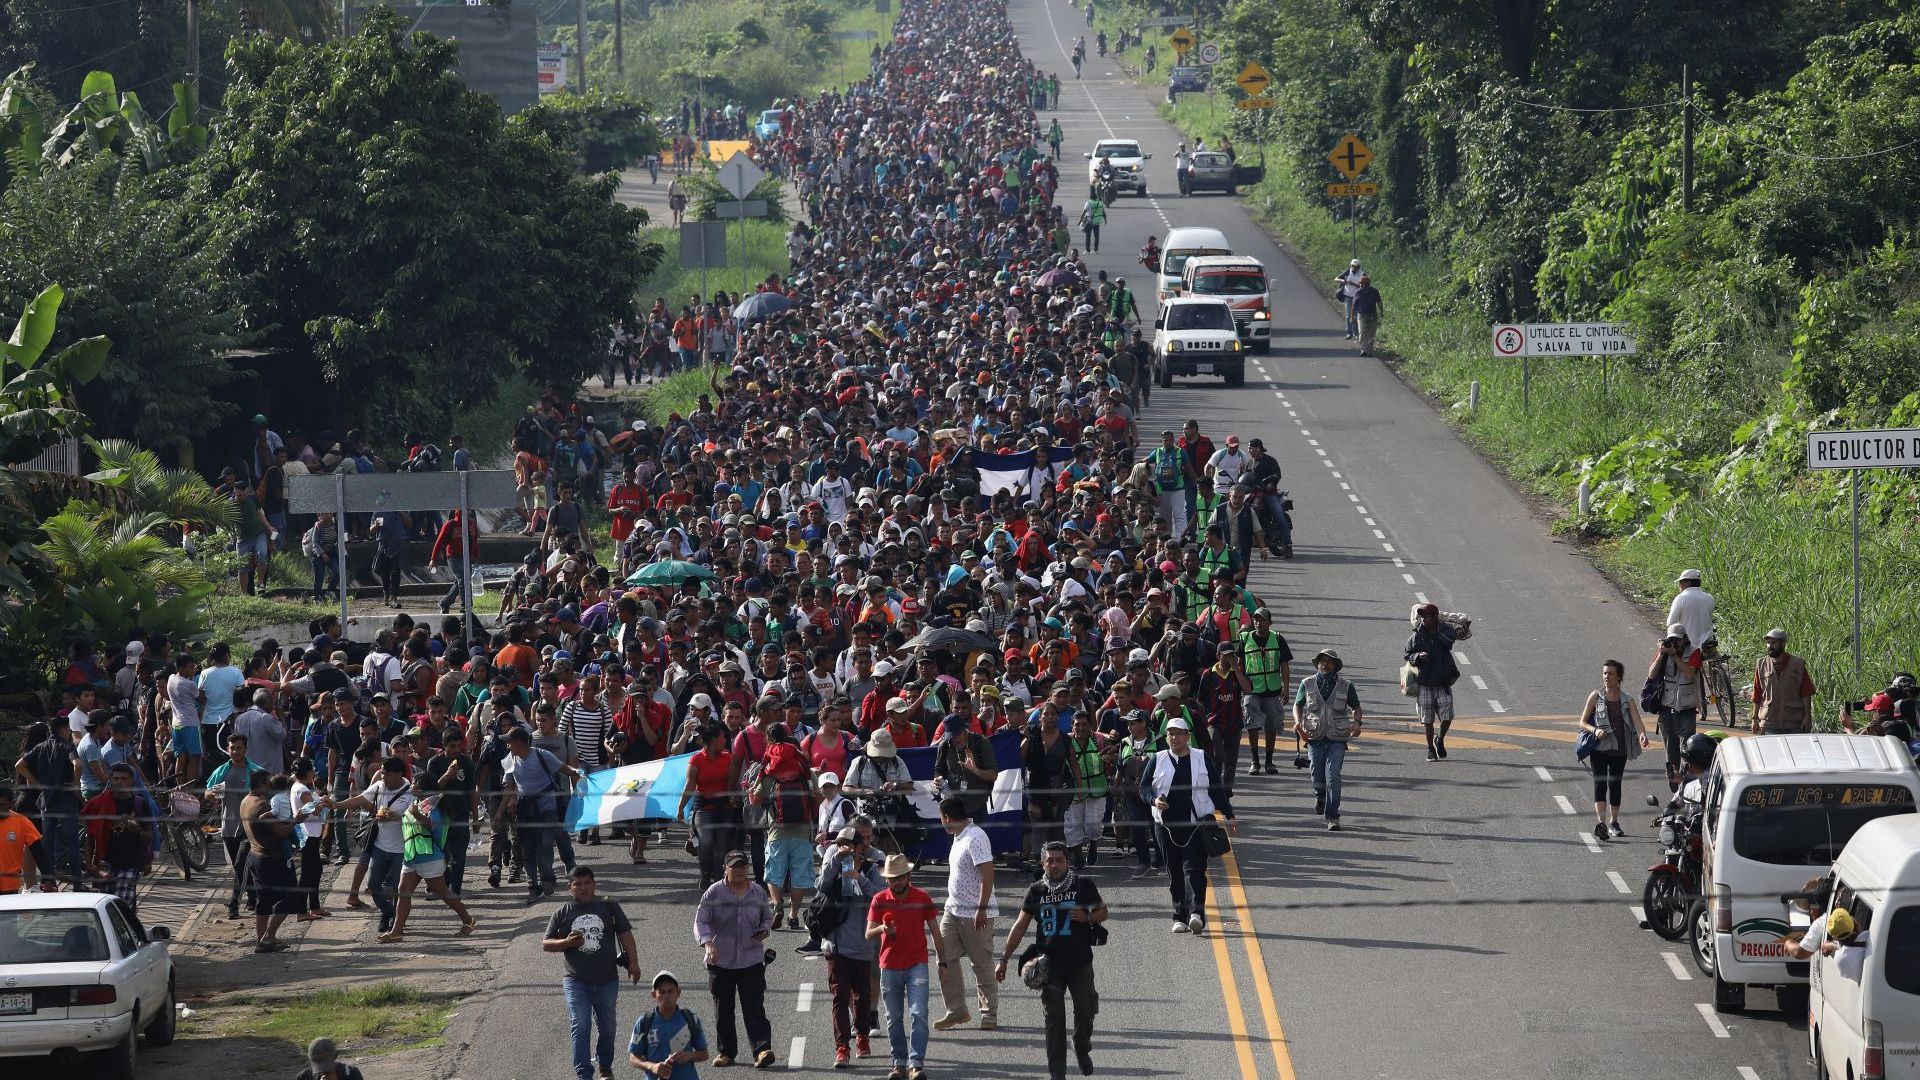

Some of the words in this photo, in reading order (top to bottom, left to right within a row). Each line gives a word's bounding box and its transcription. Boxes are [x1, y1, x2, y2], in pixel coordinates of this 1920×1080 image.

[1205, 49, 1215, 57] 40
[1332, 186, 1339, 194] A
[1344, 185, 1361, 194] 250
[1529, 328, 1565, 338] UTILICE
[1570, 327, 1581, 338] EL
[1586, 326, 1627, 337] CINTURO
[1537, 342, 1571, 352] SALVA
[1581, 341, 1593, 351] TU
[1602, 341, 1627, 351] VIDA
[1818, 438, 1905, 461] REDUCTOR
[1741, 942, 1790, 957] PRECAUCI
